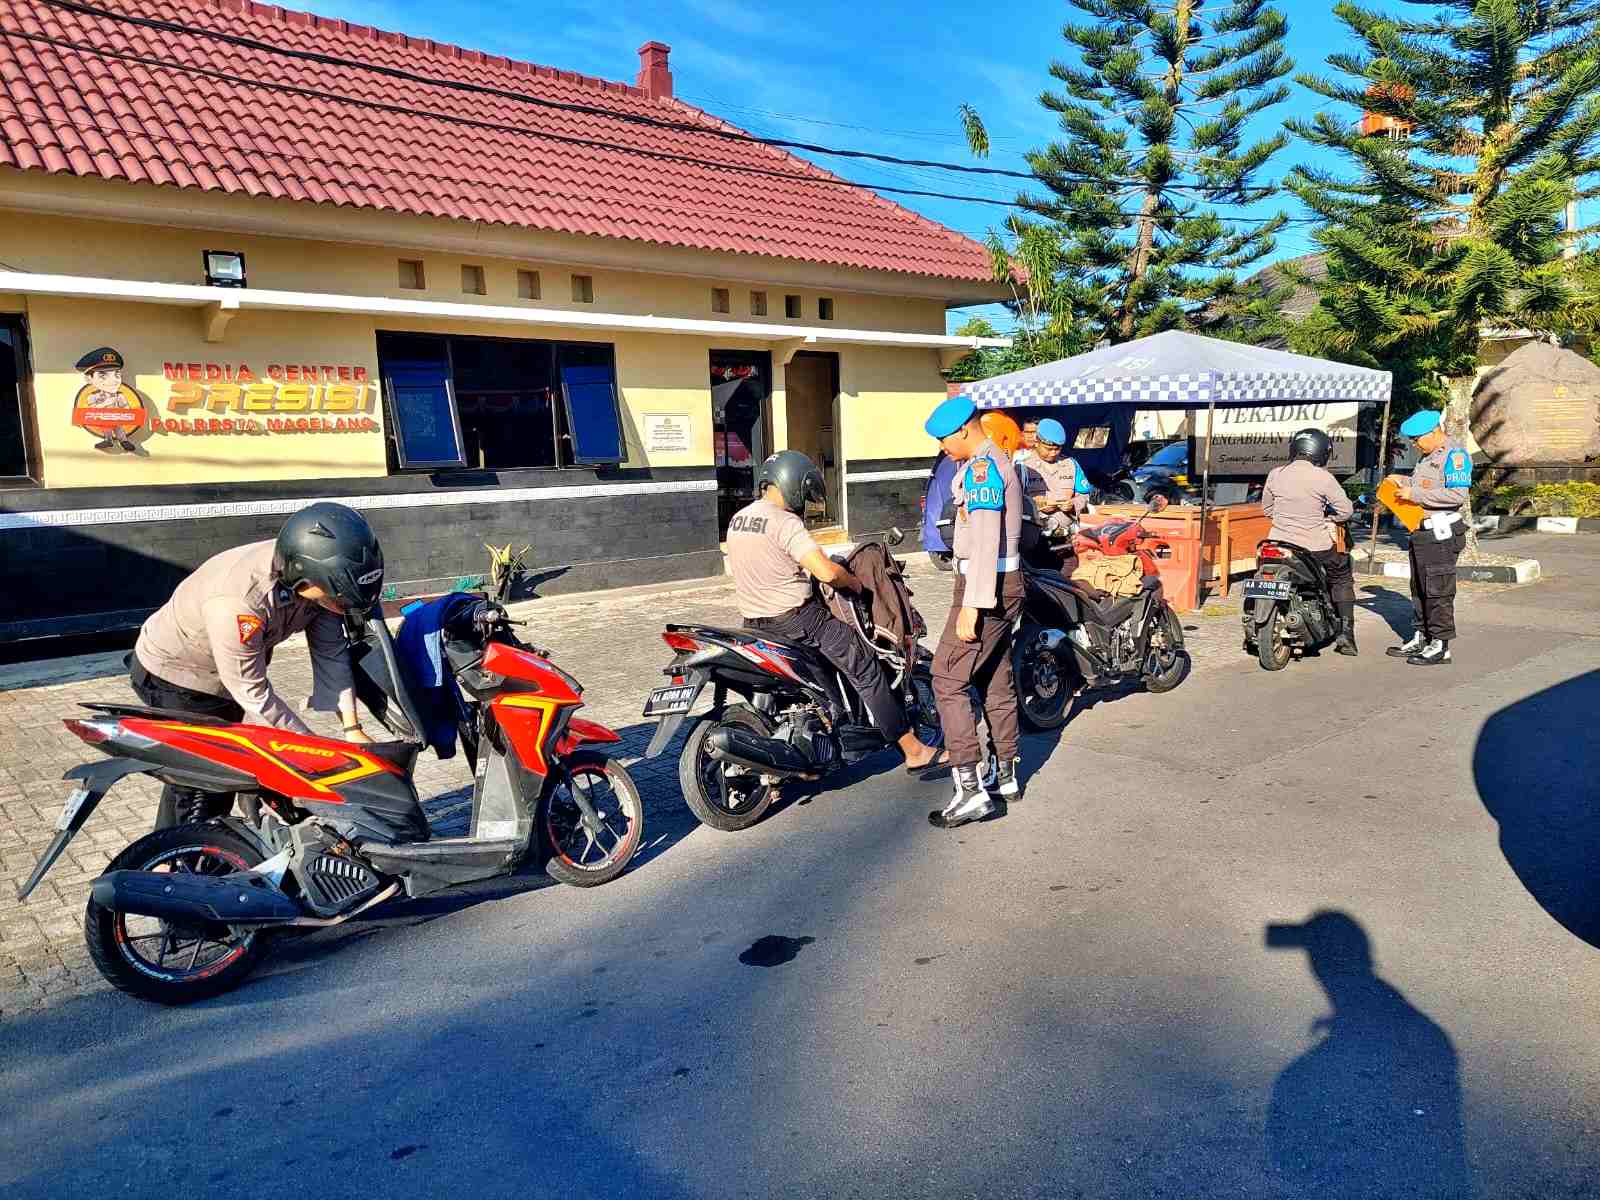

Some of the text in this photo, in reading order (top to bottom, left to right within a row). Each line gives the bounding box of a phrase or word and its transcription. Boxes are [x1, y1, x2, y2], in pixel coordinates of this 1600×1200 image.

[163, 362, 367, 382] MEDIA CENTER
[167, 383, 369, 411] PRESISI
[1222, 403, 1328, 424] TEKADKU
[151, 416, 373, 433] POLRESTA MAGELANG
[1212, 429, 1284, 446] ENGABDIAN
